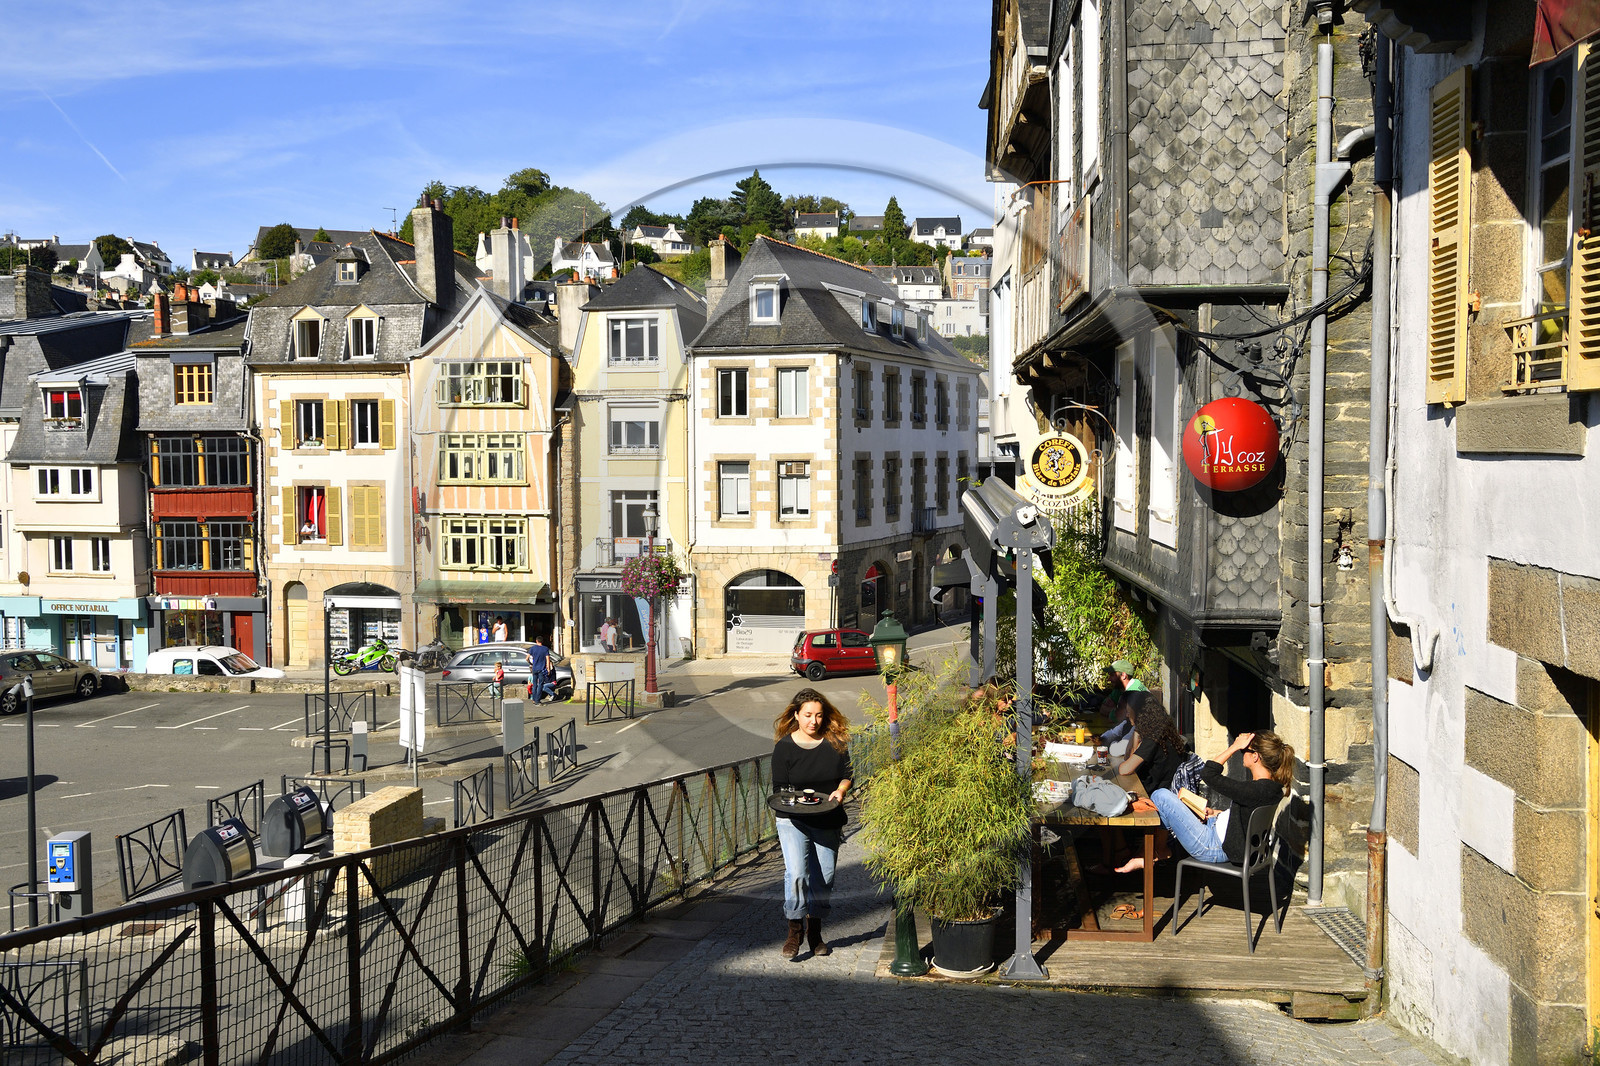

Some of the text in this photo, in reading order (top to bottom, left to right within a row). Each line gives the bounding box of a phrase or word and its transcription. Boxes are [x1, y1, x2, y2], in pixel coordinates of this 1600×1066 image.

[1038, 438, 1076, 451] COREFF
[1208, 428, 1234, 466] Ty
[1032, 463, 1081, 487] Bière de Morlaix
[1031, 493, 1042, 503] TY
[1042, 499, 1061, 508] COZ
[1063, 495, 1081, 507] BAR
[51, 603, 109, 613] OFFICE NOTARIAL
